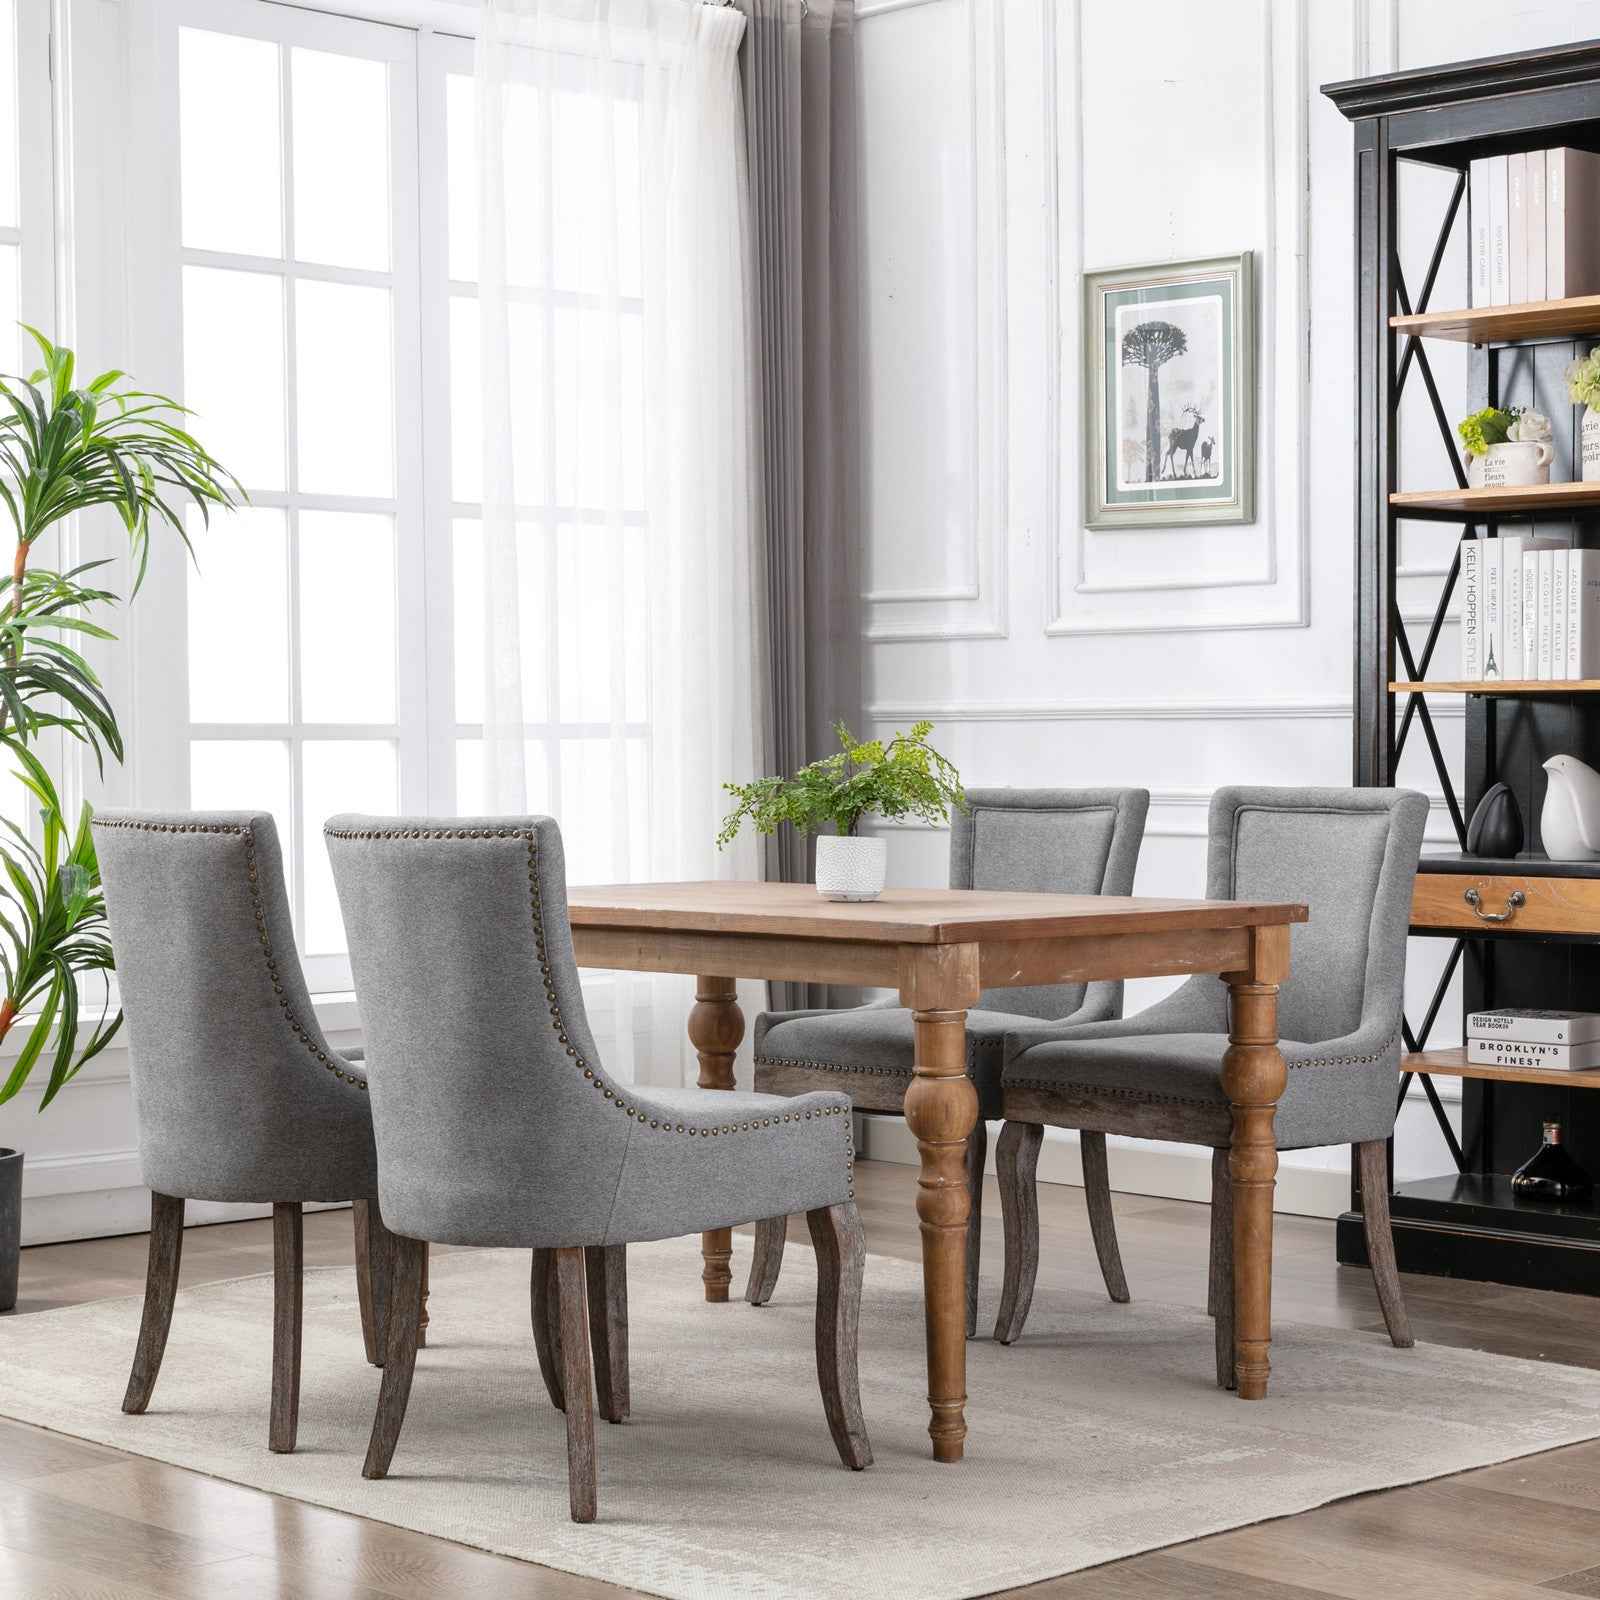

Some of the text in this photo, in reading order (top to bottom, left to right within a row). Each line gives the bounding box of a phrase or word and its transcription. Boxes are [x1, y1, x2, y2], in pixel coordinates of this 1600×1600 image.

[1466, 546, 1477, 675] KELLY HOPPEN STYLE
[1479, 1042, 1559, 1055] BROOKLYN'S
[1496, 1056, 1542, 1066] FINEST
